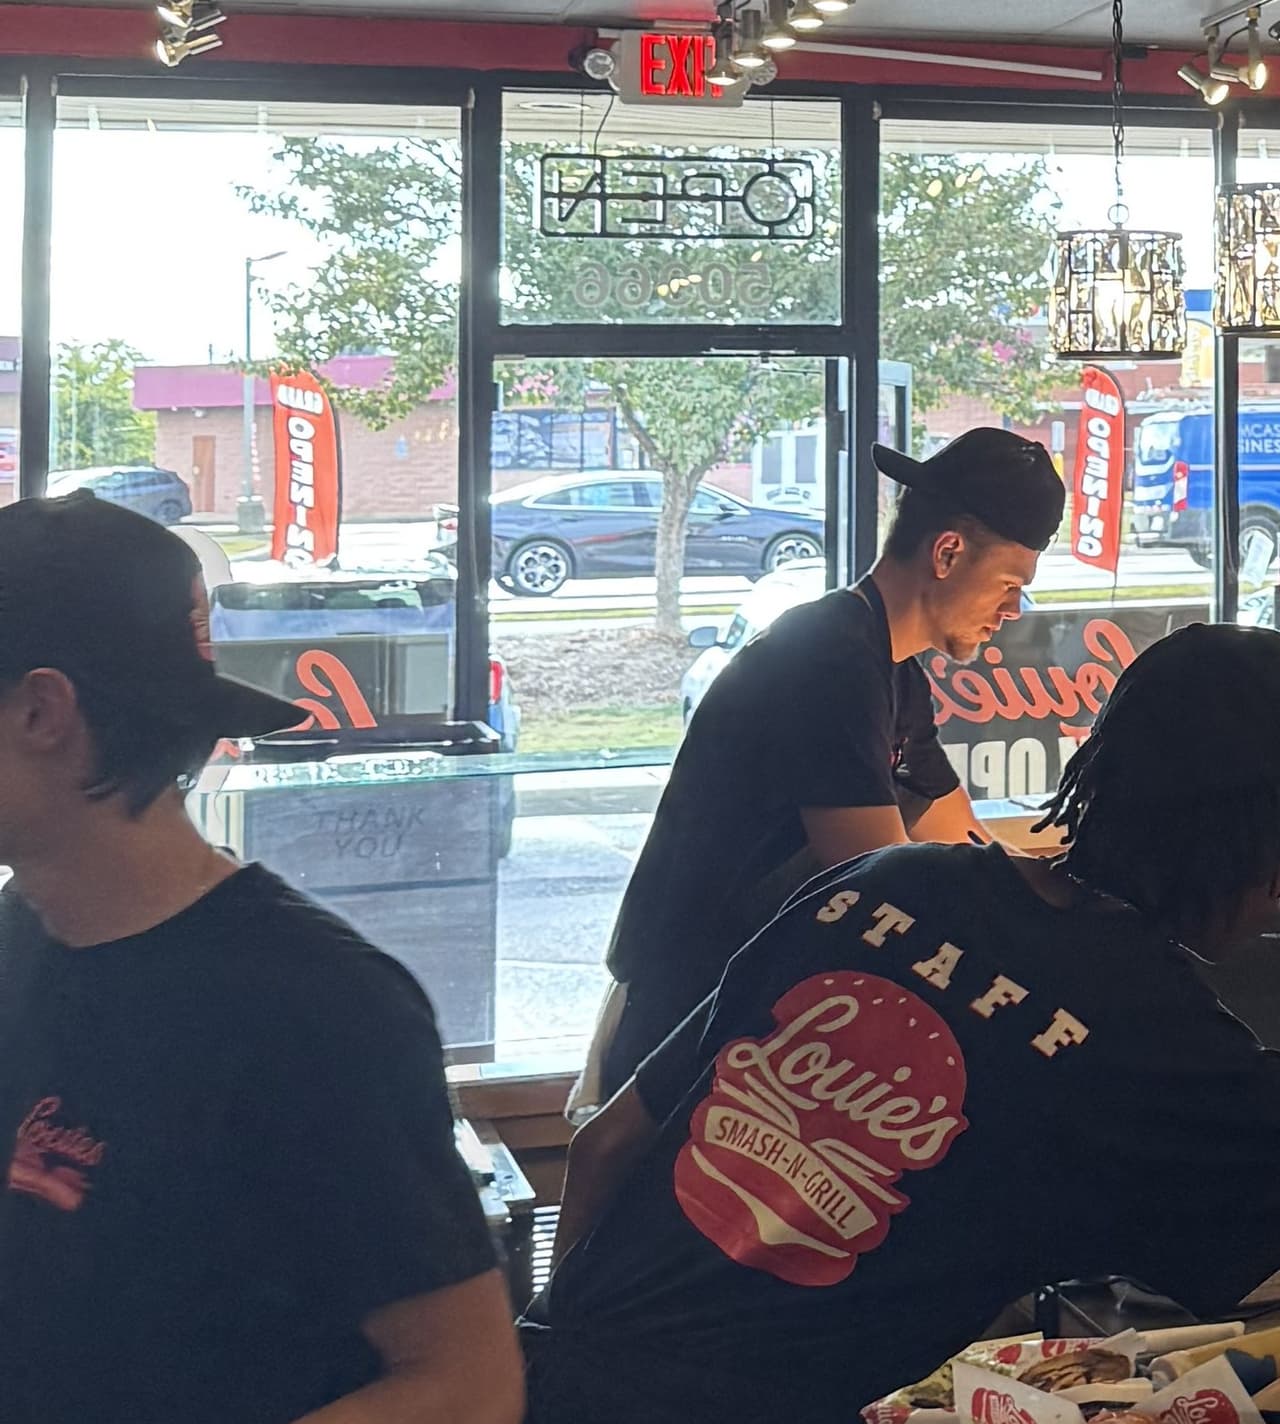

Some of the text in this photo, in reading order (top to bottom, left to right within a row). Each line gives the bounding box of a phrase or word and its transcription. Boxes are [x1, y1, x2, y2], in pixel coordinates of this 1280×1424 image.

[313, 805, 425, 835] THANK
[335, 831, 407, 859] YOU
[815, 889, 1090, 1058] STAFF
[726, 994, 959, 1161] Louie's
[715, 1115, 850, 1231] SMASH-N-GRILL
